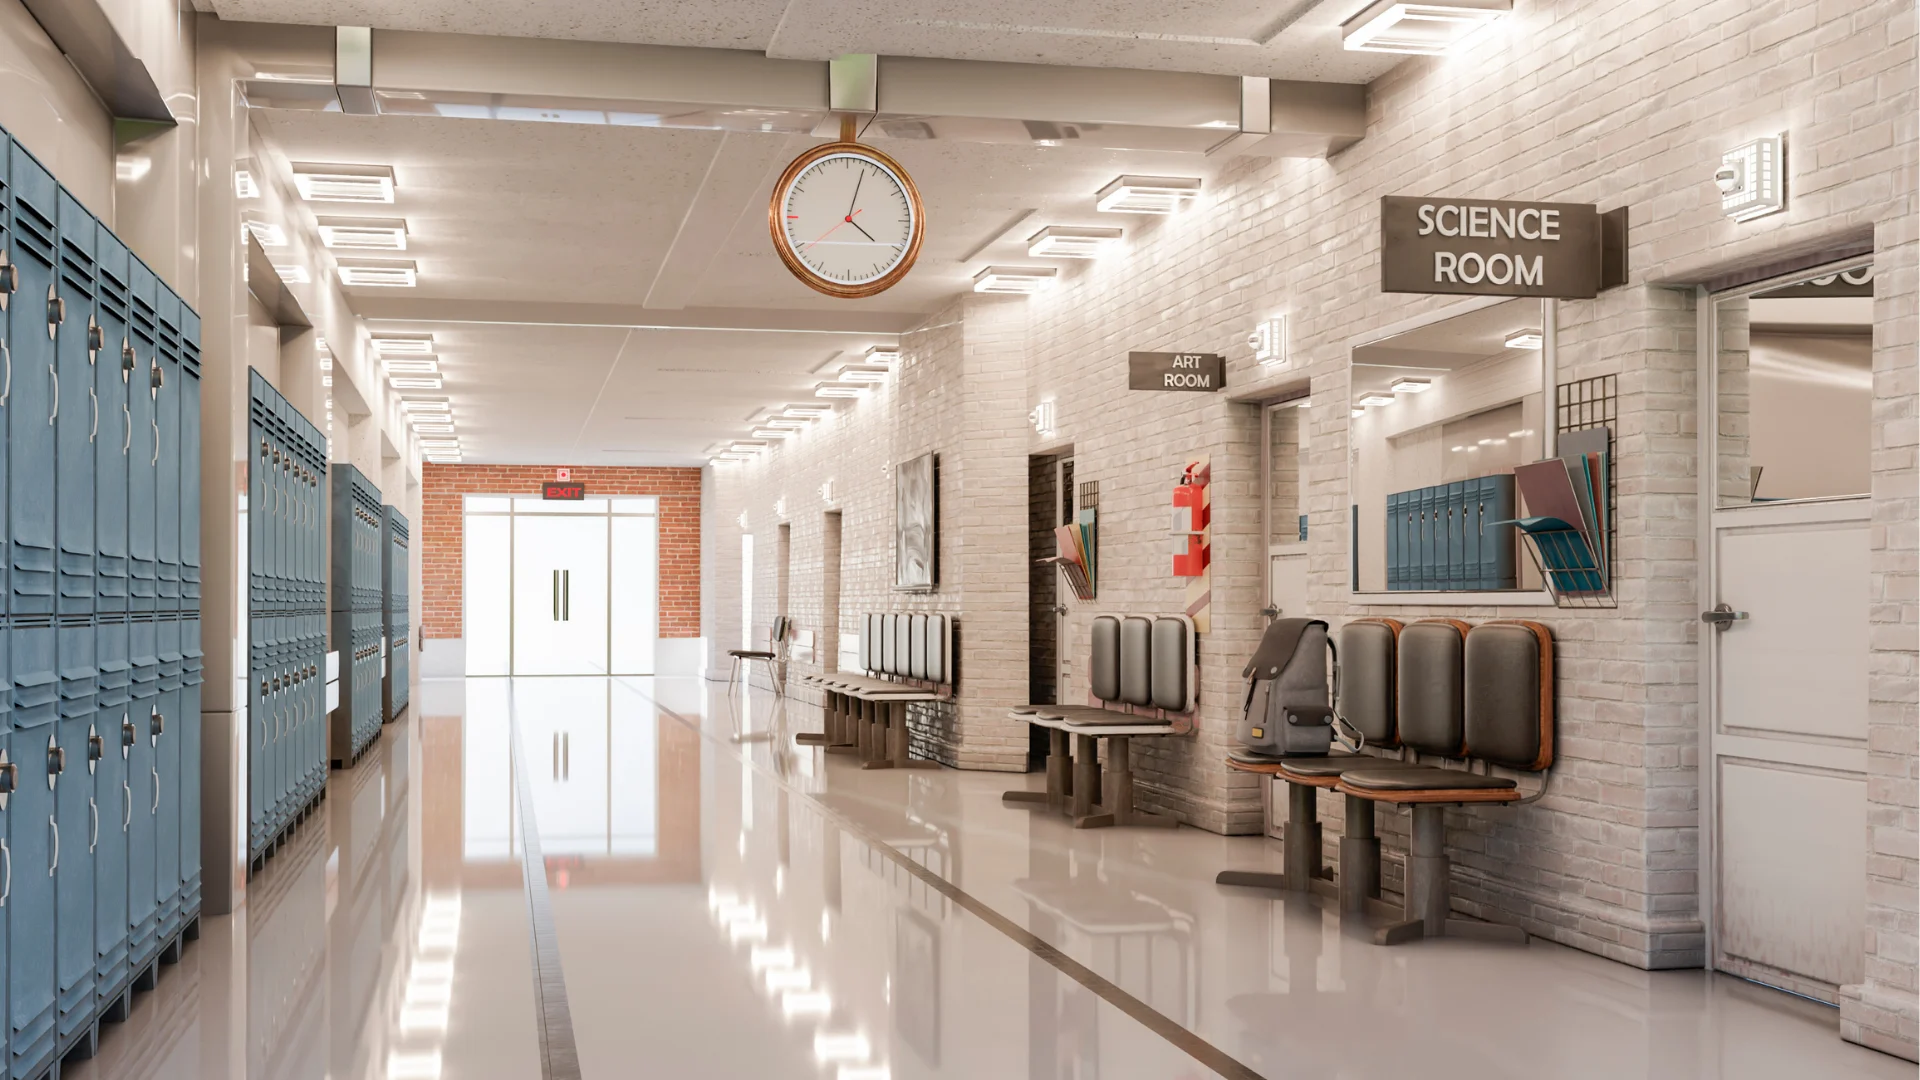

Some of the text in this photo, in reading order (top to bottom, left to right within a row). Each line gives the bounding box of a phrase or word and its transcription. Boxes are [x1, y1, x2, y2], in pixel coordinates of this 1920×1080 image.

[1417, 204, 1561, 241] SCIENCE
[1434, 251, 1544, 286] ROOM
[1172, 354, 1202, 369] ART
[1164, 373, 1210, 388] ROOM
[546, 487, 582, 498] EXIT
